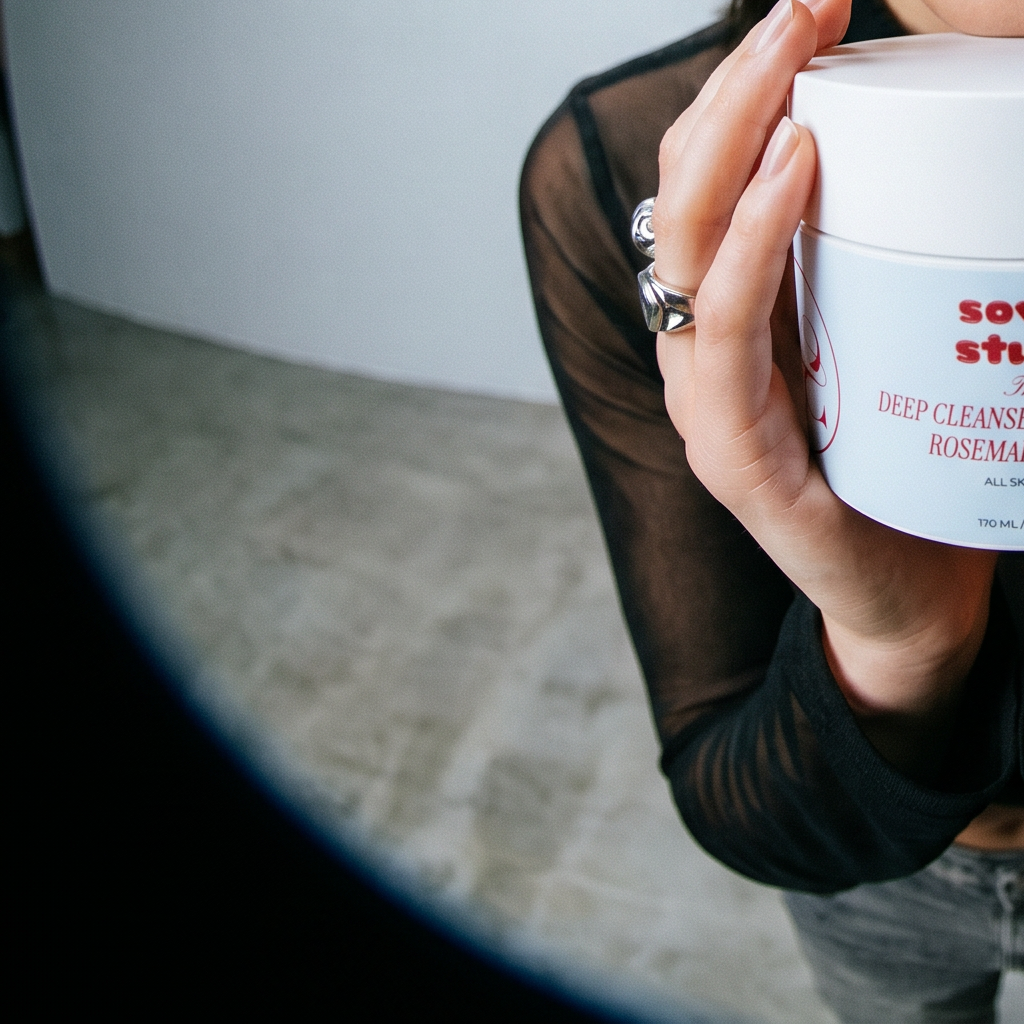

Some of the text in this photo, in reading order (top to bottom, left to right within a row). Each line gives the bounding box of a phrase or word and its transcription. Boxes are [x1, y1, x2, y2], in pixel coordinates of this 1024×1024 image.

[878, 390, 929, 422] DEEP
[983, 477, 1008, 488] ALL
[977, 518, 998, 529] 170
[999, 519, 1019, 530] ML
